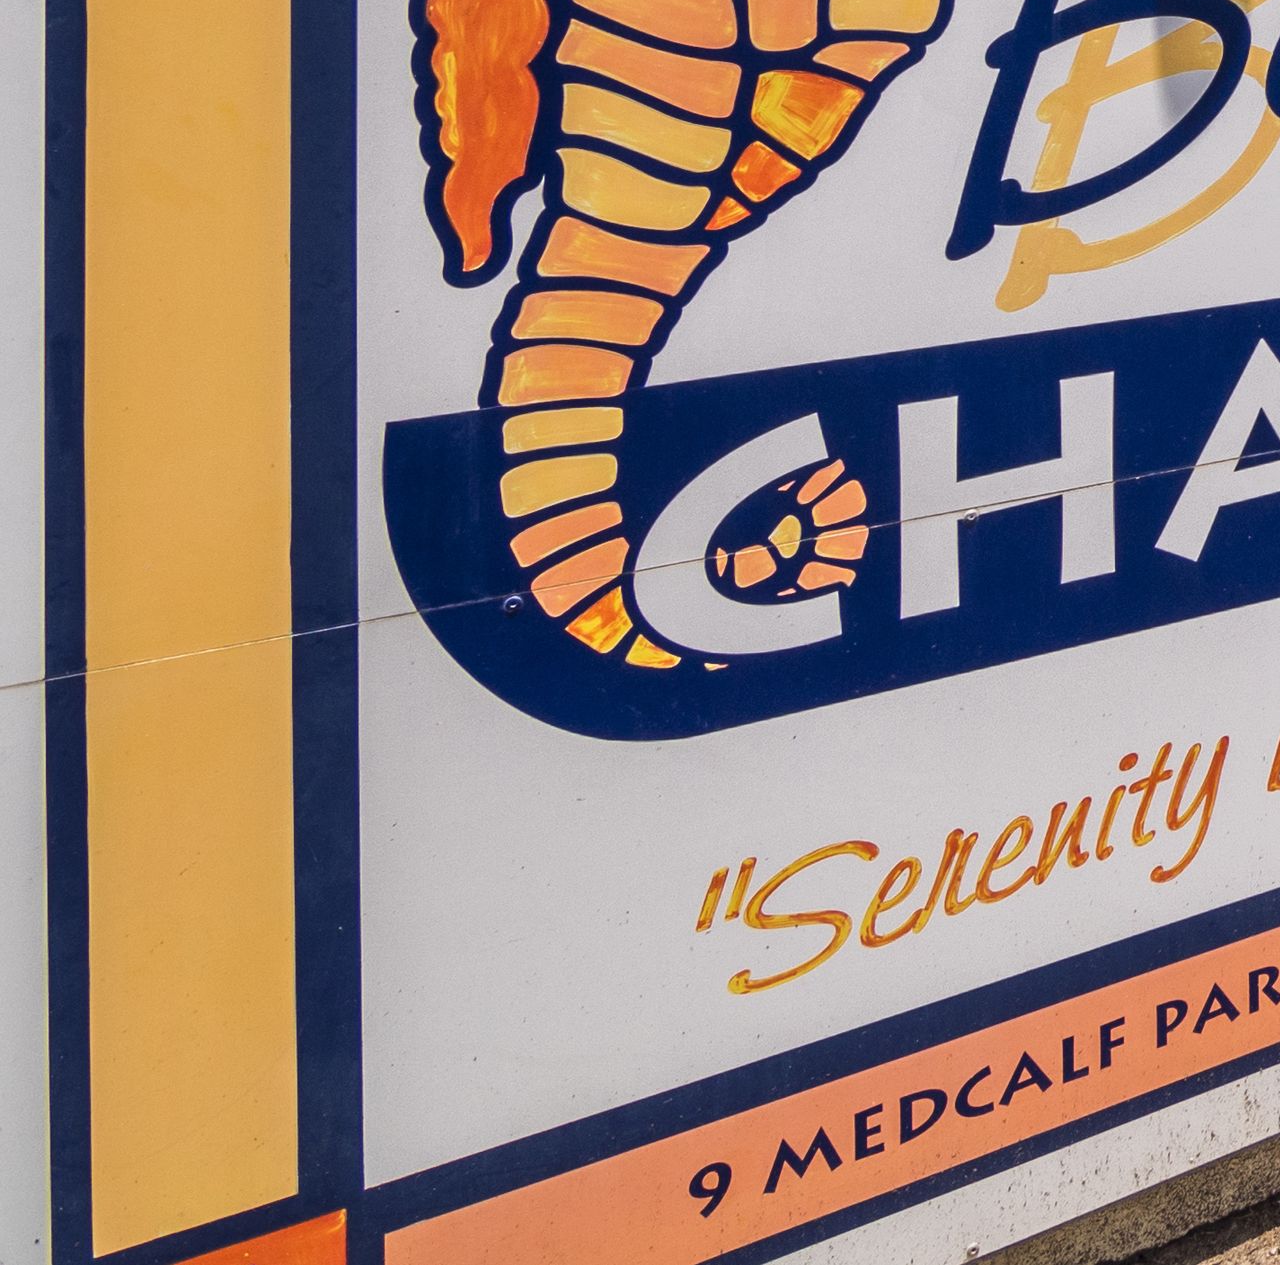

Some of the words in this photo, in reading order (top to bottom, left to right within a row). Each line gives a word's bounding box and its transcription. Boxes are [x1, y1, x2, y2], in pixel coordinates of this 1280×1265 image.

[694, 735, 1231, 997] "Serenity
[688, 1162, 733, 1219] 9
[762, 1012, 1128, 1197] MEDCALF
